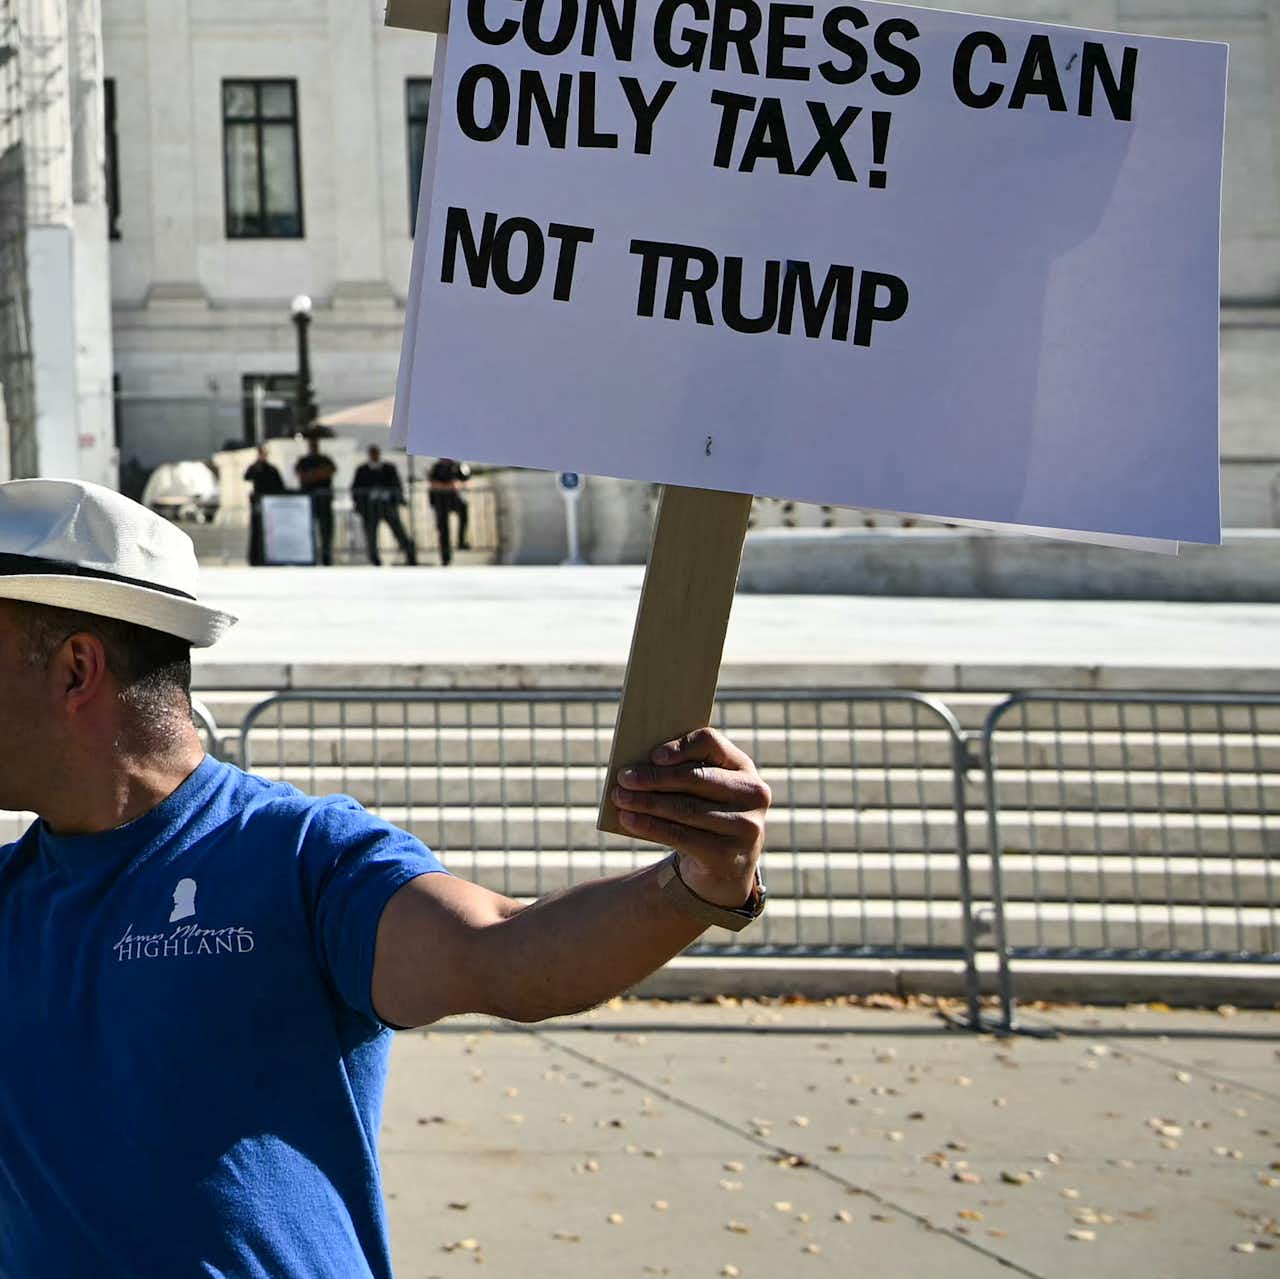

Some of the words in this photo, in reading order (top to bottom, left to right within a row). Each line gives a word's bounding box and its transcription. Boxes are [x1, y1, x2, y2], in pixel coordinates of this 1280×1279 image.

[456, 63, 677, 156] ONLY
[710, 88, 892, 189] TAX!
[952, 30, 1139, 122] CAN
[440, 206, 595, 302] NOT
[629, 238, 909, 348] TRUMP
[118, 934, 255, 962] HIGHLAND
